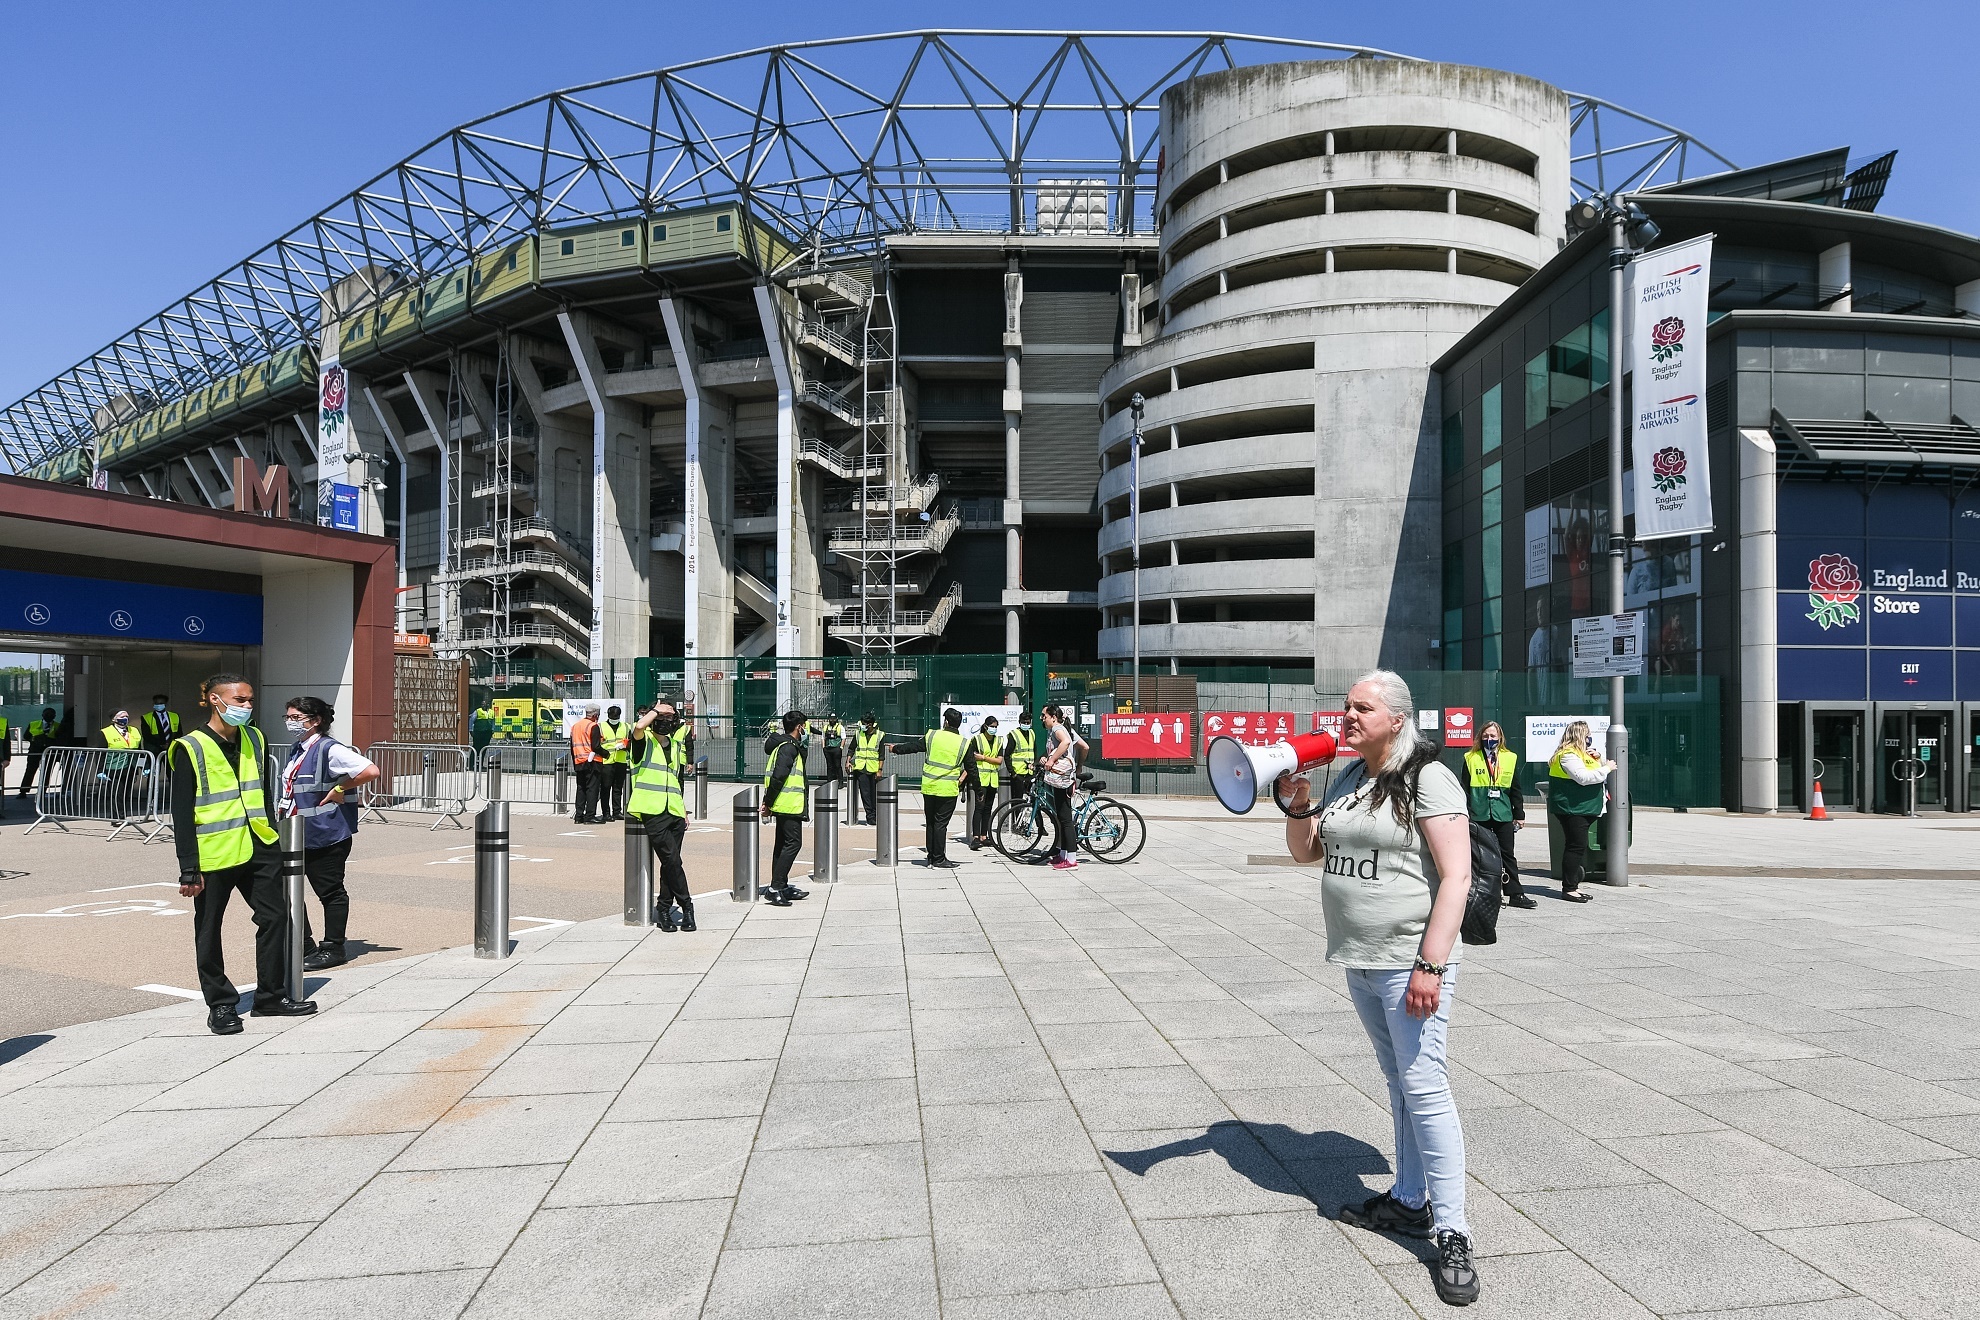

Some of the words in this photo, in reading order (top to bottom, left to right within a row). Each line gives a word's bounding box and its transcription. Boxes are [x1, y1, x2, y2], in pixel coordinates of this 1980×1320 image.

[1643, 277, 1681, 295] BRITISH
[1641, 285, 1682, 304] AIRWAYS
[1651, 361, 1682, 376] England
[1654, 369, 1679, 382] Rugby
[1640, 405, 1678, 422] BRITISH
[1638, 414, 1680, 431] AIRWAYS
[322, 438, 344, 455] England
[324, 452, 341, 466] Rugby
[233, 456, 289, 518] M
[1654, 492, 1687, 506] England
[1658, 500, 1684, 512] Rugby
[1873, 569, 1948, 591] England
[1957, 571, 1980, 593] Ru
[1873, 596, 1920, 614] Store
[394, 634, 407, 643] UBLIC
[1901, 664, 1920, 673] EXIT
[1109, 718, 1116, 726] DO
[1116, 718, 1130, 726] YOUR
[1131, 718, 1146, 727] PART,
[1320, 716, 1336, 725] HELP
[1109, 726, 1121, 734] STAY
[1122, 726, 1139, 734] APART
[1917, 738, 1938, 746] EXIT
[1323, 843, 1379, 881] kind
